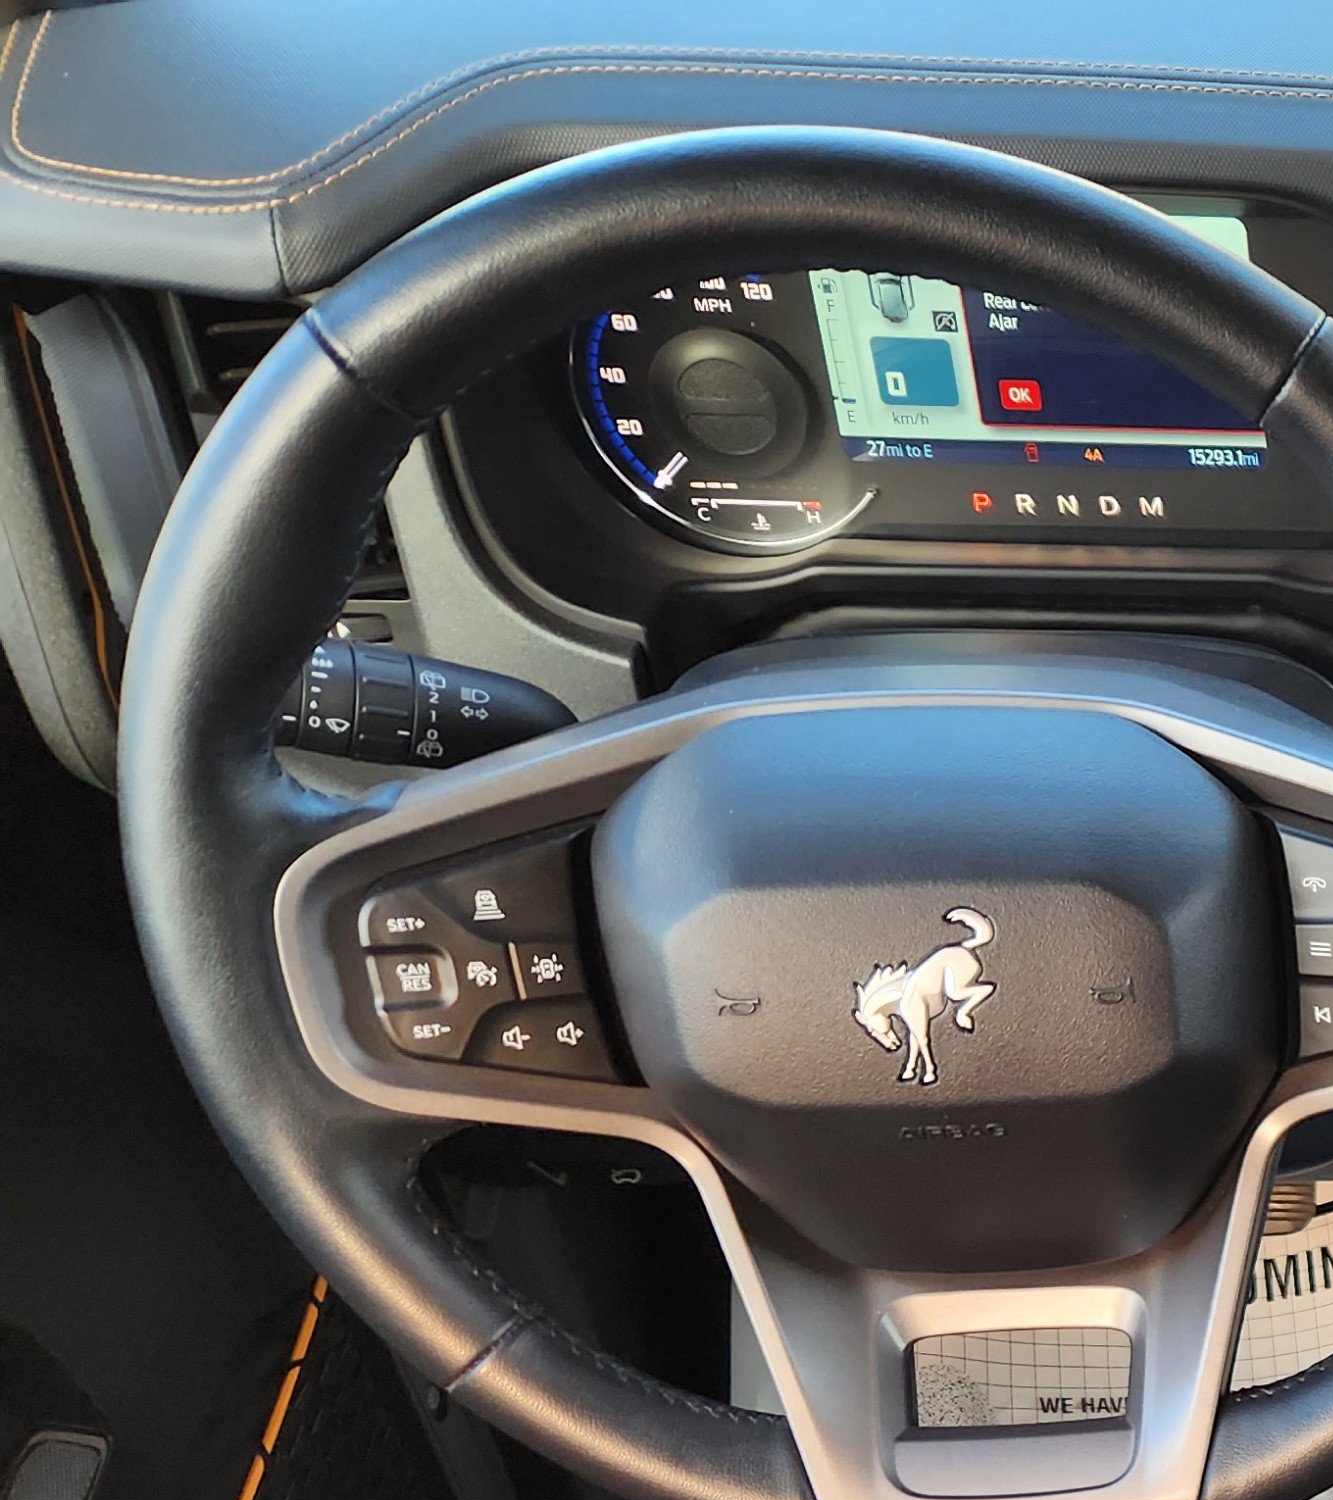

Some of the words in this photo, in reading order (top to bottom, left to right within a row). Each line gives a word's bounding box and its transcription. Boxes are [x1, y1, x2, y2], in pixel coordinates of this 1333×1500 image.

[740, 281, 774, 301] 120
[693, 297, 733, 314] MPH
[826, 299, 836, 313] F
[610, 313, 639, 332] 60
[988, 313, 1020, 332] Ajar
[599, 366, 627, 384] 40
[885, 371, 908, 397] 0
[1008, 387, 1033, 404] OK
[847, 410, 857, 423] E
[892, 412, 930, 426] km/h
[616, 418, 643, 436] 20
[905, 444, 921, 458] to
[923, 443, 934, 458] E
[1084, 447, 1104, 463] 4A
[972, 491, 993, 514] P
[1015, 492, 1038, 516] R
[1056, 493, 1080, 517] N
[1099, 494, 1122, 517] D
[1139, 495, 1164, 518] M
[697, 507, 711, 522] C
[806, 511, 821, 524] H
[428, 691, 439, 704] 2
[430, 709, 437, 722] 1
[427, 728, 438, 741] 0
[396, 962, 431, 976] CAN
[401, 977, 432, 993] RES
[1039, 1396, 1074, 1414] WE
[1081, 1396, 1128, 1414] HAV
